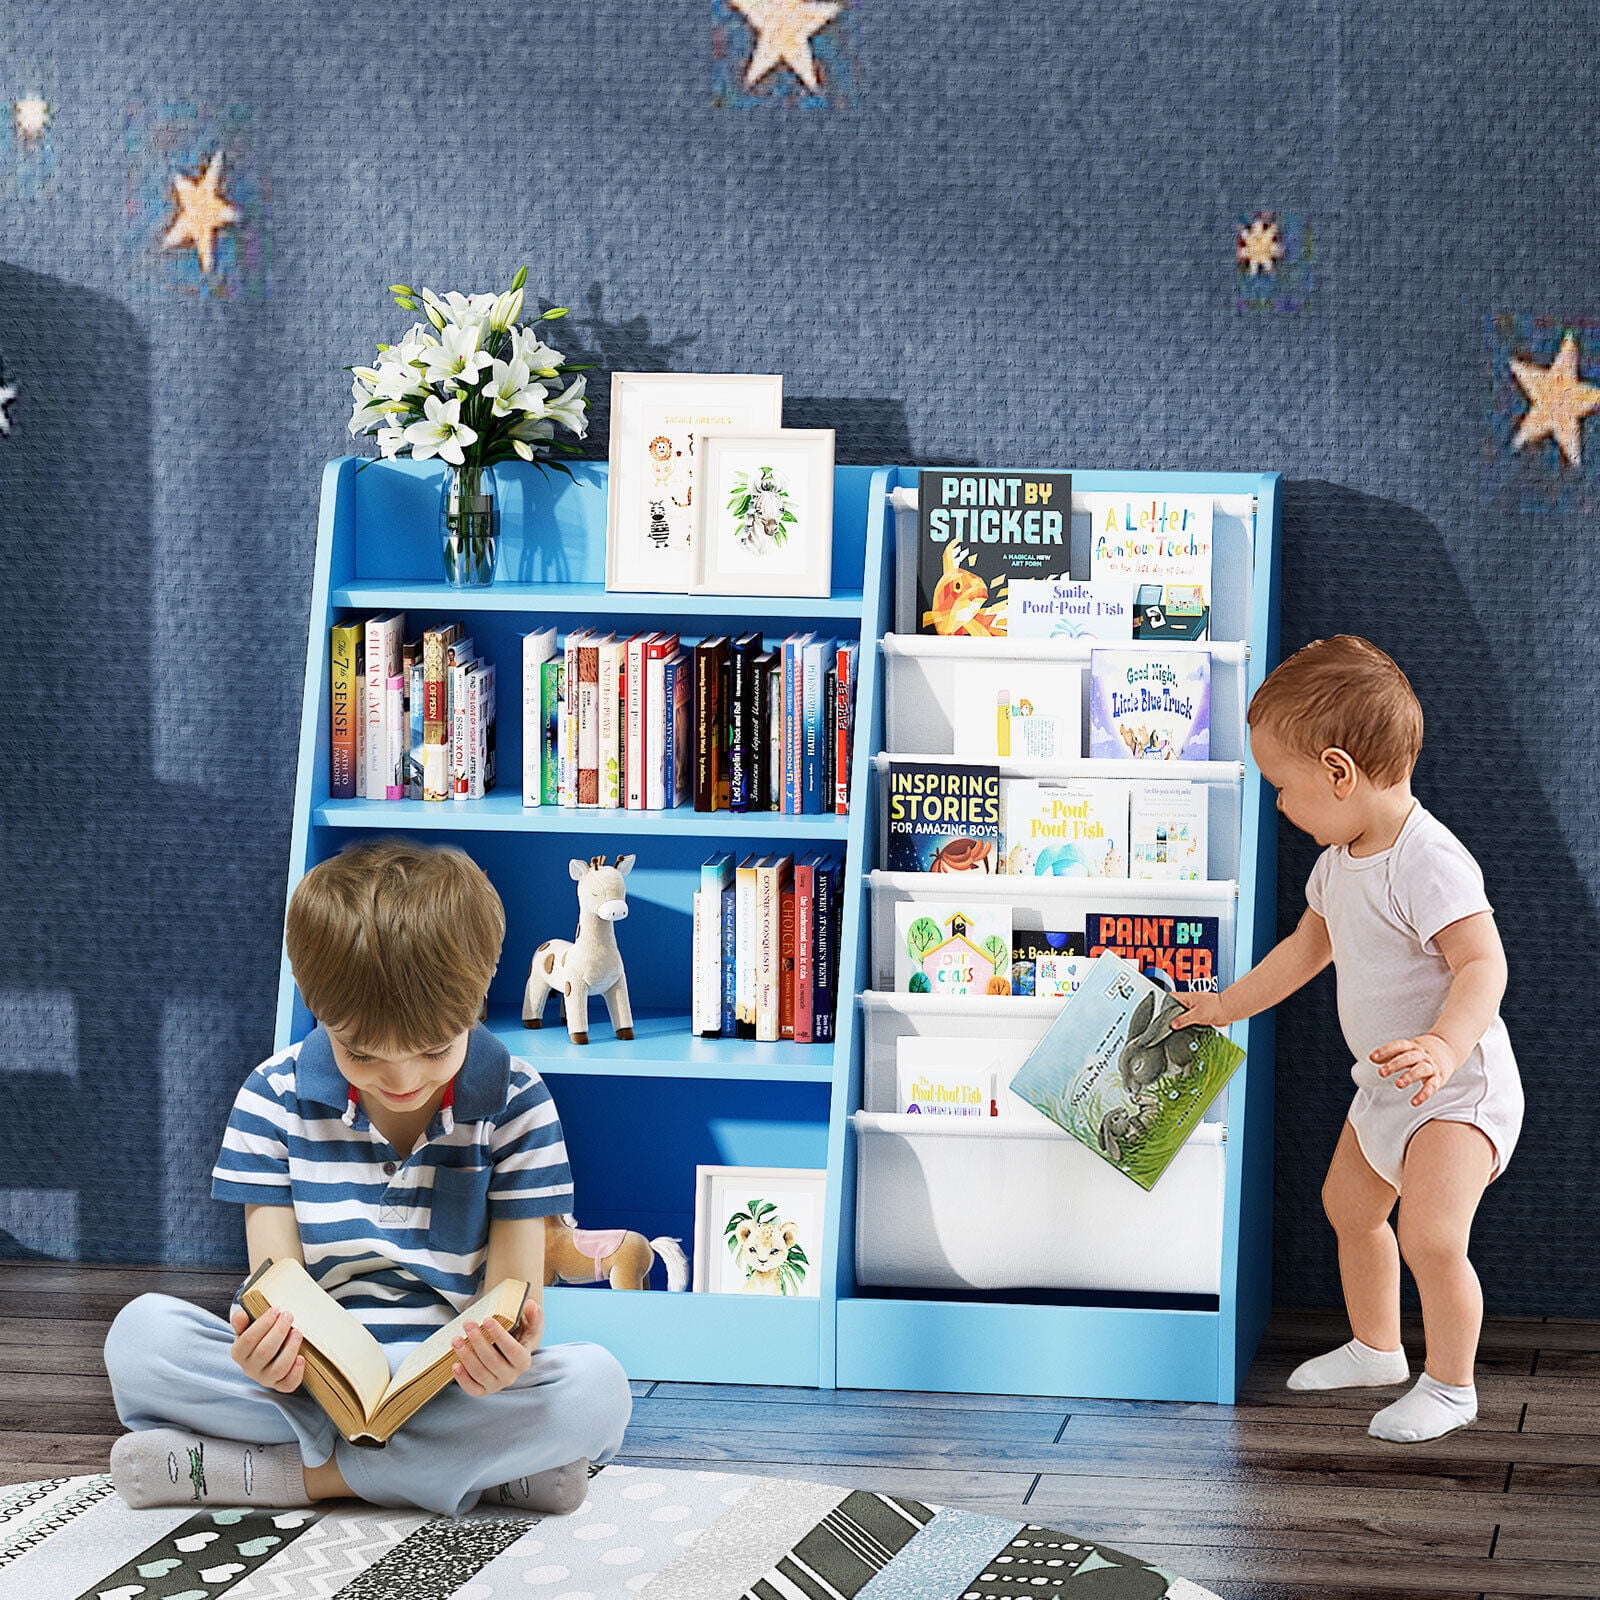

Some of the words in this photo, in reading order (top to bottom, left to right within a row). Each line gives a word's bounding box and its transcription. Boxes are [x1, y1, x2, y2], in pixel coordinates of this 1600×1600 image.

[941, 477, 1022, 506] PAINT
[1024, 483, 1053, 505] BY
[929, 508, 1064, 545] STICKER
[1105, 507, 1119, 532] A
[1125, 501, 1196, 533] Letter
[1096, 536, 1124, 560] from
[1126, 540, 1154, 558] your
[1155, 533, 1209, 557] Teacher
[1053, 585, 1093, 599] Smile,
[1022, 600, 1091, 614] Pout-Pout
[1097, 603, 1124, 616] Fish
[337, 639, 347, 657] The
[1126, 663, 1149, 685] Good
[430, 685, 437, 697] OF
[334, 681, 348, 737] SENSE
[734, 702, 742, 714] Roll
[1112, 692, 1139, 718] Little
[1141, 688, 1162, 712] Blue
[1163, 688, 1193, 720] Truck
[734, 715, 742, 727] and
[734, 728, 742, 744] Rock
[751, 718, 761, 751] берегов
[807, 726, 815, 756] НАШИ
[333, 747, 341, 787] PARADISE
[342, 771, 349, 785] TO
[733, 753, 743, 786] Zeppelin
[750, 764, 759, 801] Записки
[891, 773, 998, 796] INSPIRING
[732, 788, 742, 802] Led
[891, 794, 999, 823] STORIES
[891, 822, 913, 834] FOR
[915, 822, 967, 836] AMAZING
[969, 824, 998, 837] BOYS
[1031, 819, 1068, 838] Pout
[1072, 820, 1104, 839] Fish
[800, 896, 809, 906] the
[818, 876, 827, 912] MYSTERY
[782, 900, 795, 955] CHOICES
[800, 907, 809, 942] handsomest
[818, 914, 827, 925] AT
[1099, 917, 1174, 946] PAINT
[1176, 922, 1203, 944] BY
[762, 920, 770, 973] CONQUESTS
[800, 943, 808, 956] man
[818, 926, 827, 961] SHARK'S
[1028, 946, 1058, 959] Book
[1060, 947, 1075, 957] of
[943, 953, 971, 966] our
[1090, 946, 1212, 981] CKER
[818, 962, 827, 988] TEETH
[1054, 981, 1080, 992] YOU
[1187, 975, 1218, 993] KIDS
[962, 1085, 982, 1104] Fish
